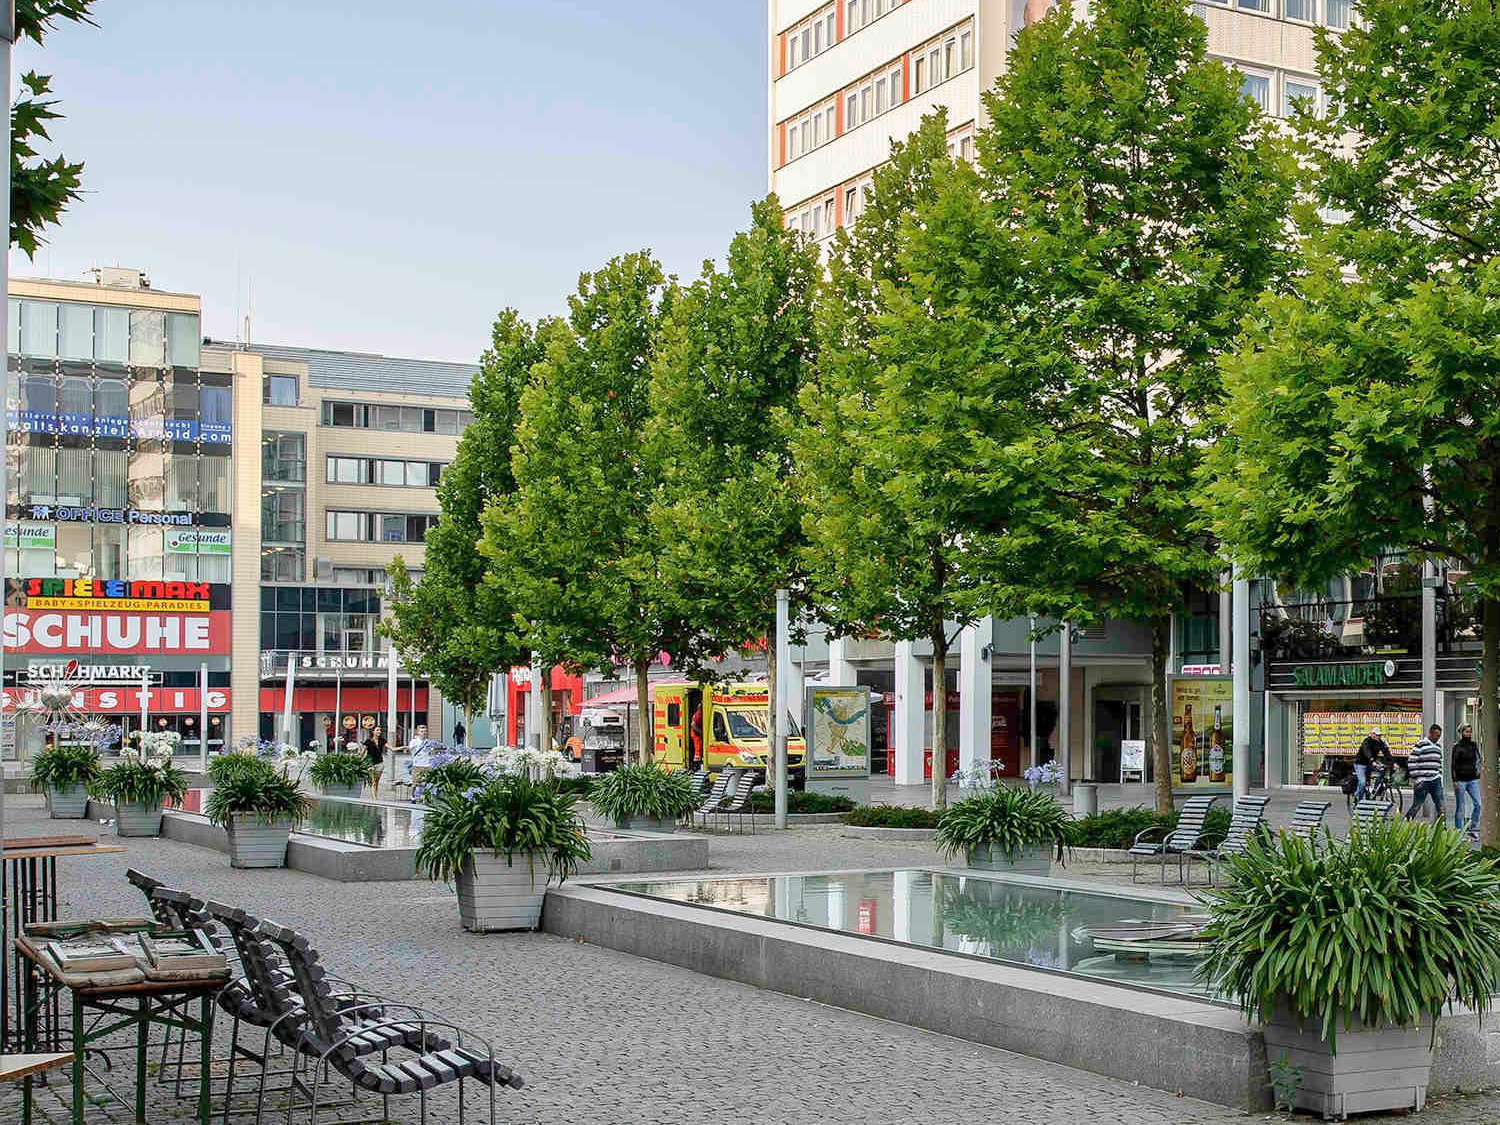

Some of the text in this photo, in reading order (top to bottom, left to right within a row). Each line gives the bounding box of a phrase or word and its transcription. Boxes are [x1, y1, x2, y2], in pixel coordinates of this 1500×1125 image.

[56, 509, 192, 525] OFFICE Personal
[5, 527, 49, 538] esunde
[178, 531, 226, 543] Gesunde
[28, 578, 209, 599] SPIELE MAX
[3, 613, 210, 649] SCHUHE
[1293, 662, 1384, 686] SALAMANDER
